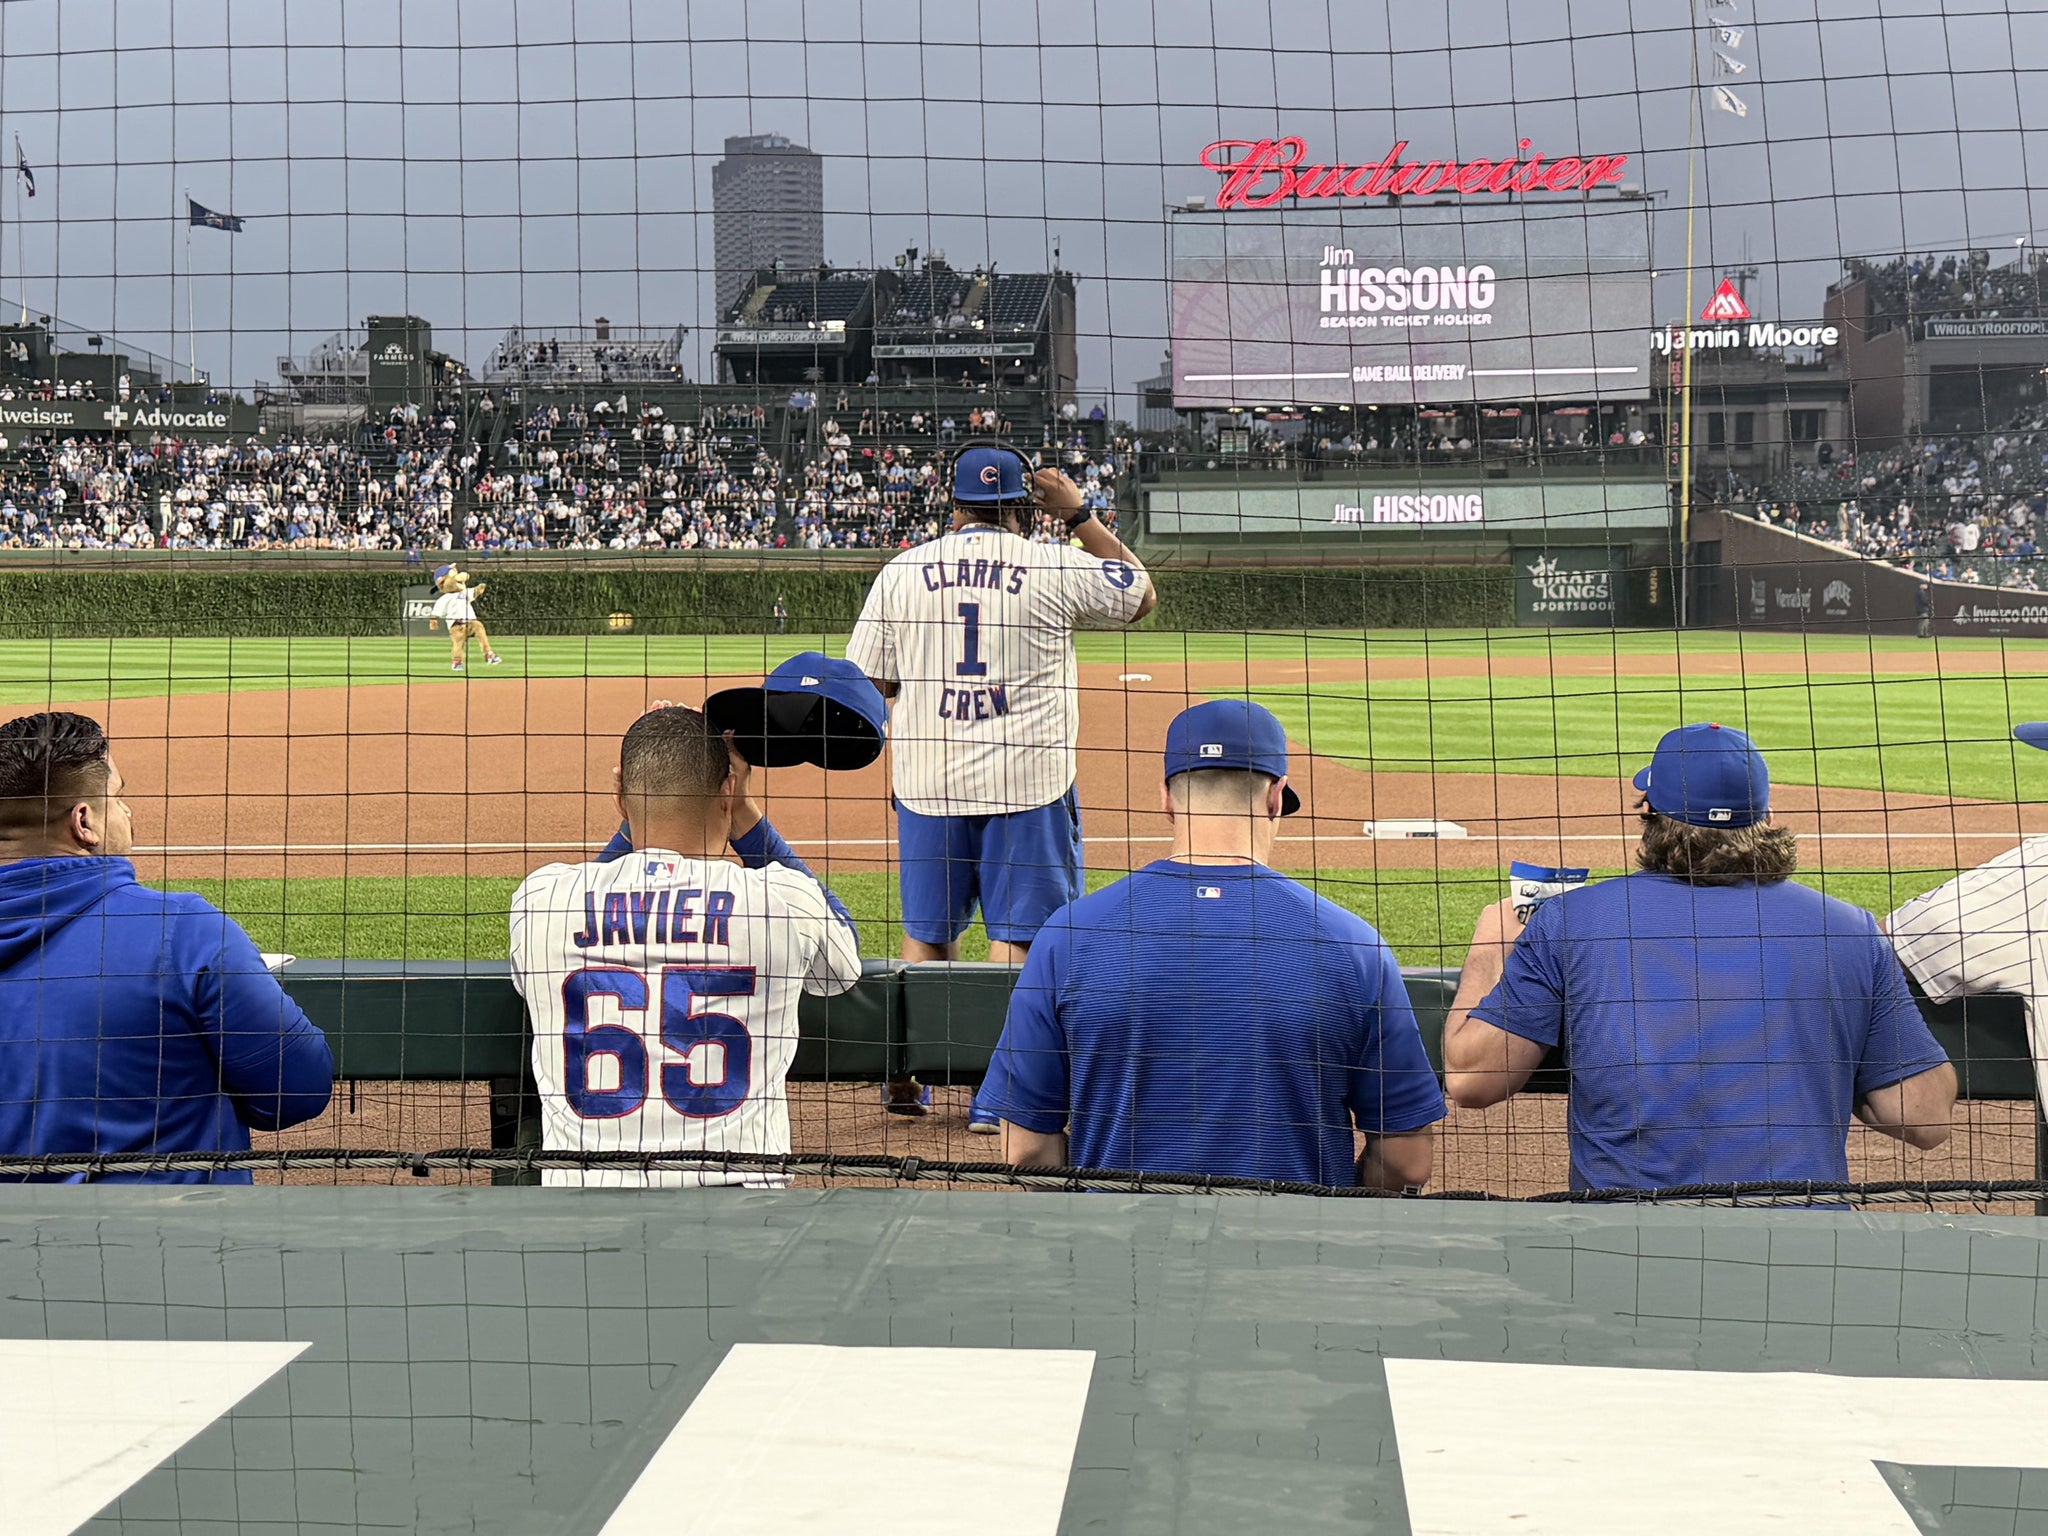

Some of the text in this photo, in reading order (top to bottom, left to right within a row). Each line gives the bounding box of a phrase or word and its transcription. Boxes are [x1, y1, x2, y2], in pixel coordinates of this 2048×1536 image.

[1200, 136, 1628, 209] Budweiser
[1320, 246, 1354, 266] Jim
[1320, 265, 1496, 312] HISSONG
[1320, 313, 1492, 328] SEASON TICKET HOLDER
[1749, 323, 1839, 348] Moore
[1353, 364, 1466, 383] GAME BALL DELIVERY
[133, 408, 226, 427] Advocate
[1331, 494, 1483, 524] Jim HISSONG
[922, 559, 1027, 595] CLARK'S
[1532, 569, 1609, 588] DRAFT
[1542, 585, 1609, 599] KINGS
[1532, 602, 1616, 612] SPORTSBOOK
[956, 602, 987, 676] 1
[938, 685, 1009, 721] CREW
[573, 889, 735, 949] JAVIER
[562, 965, 757, 1120] 65
